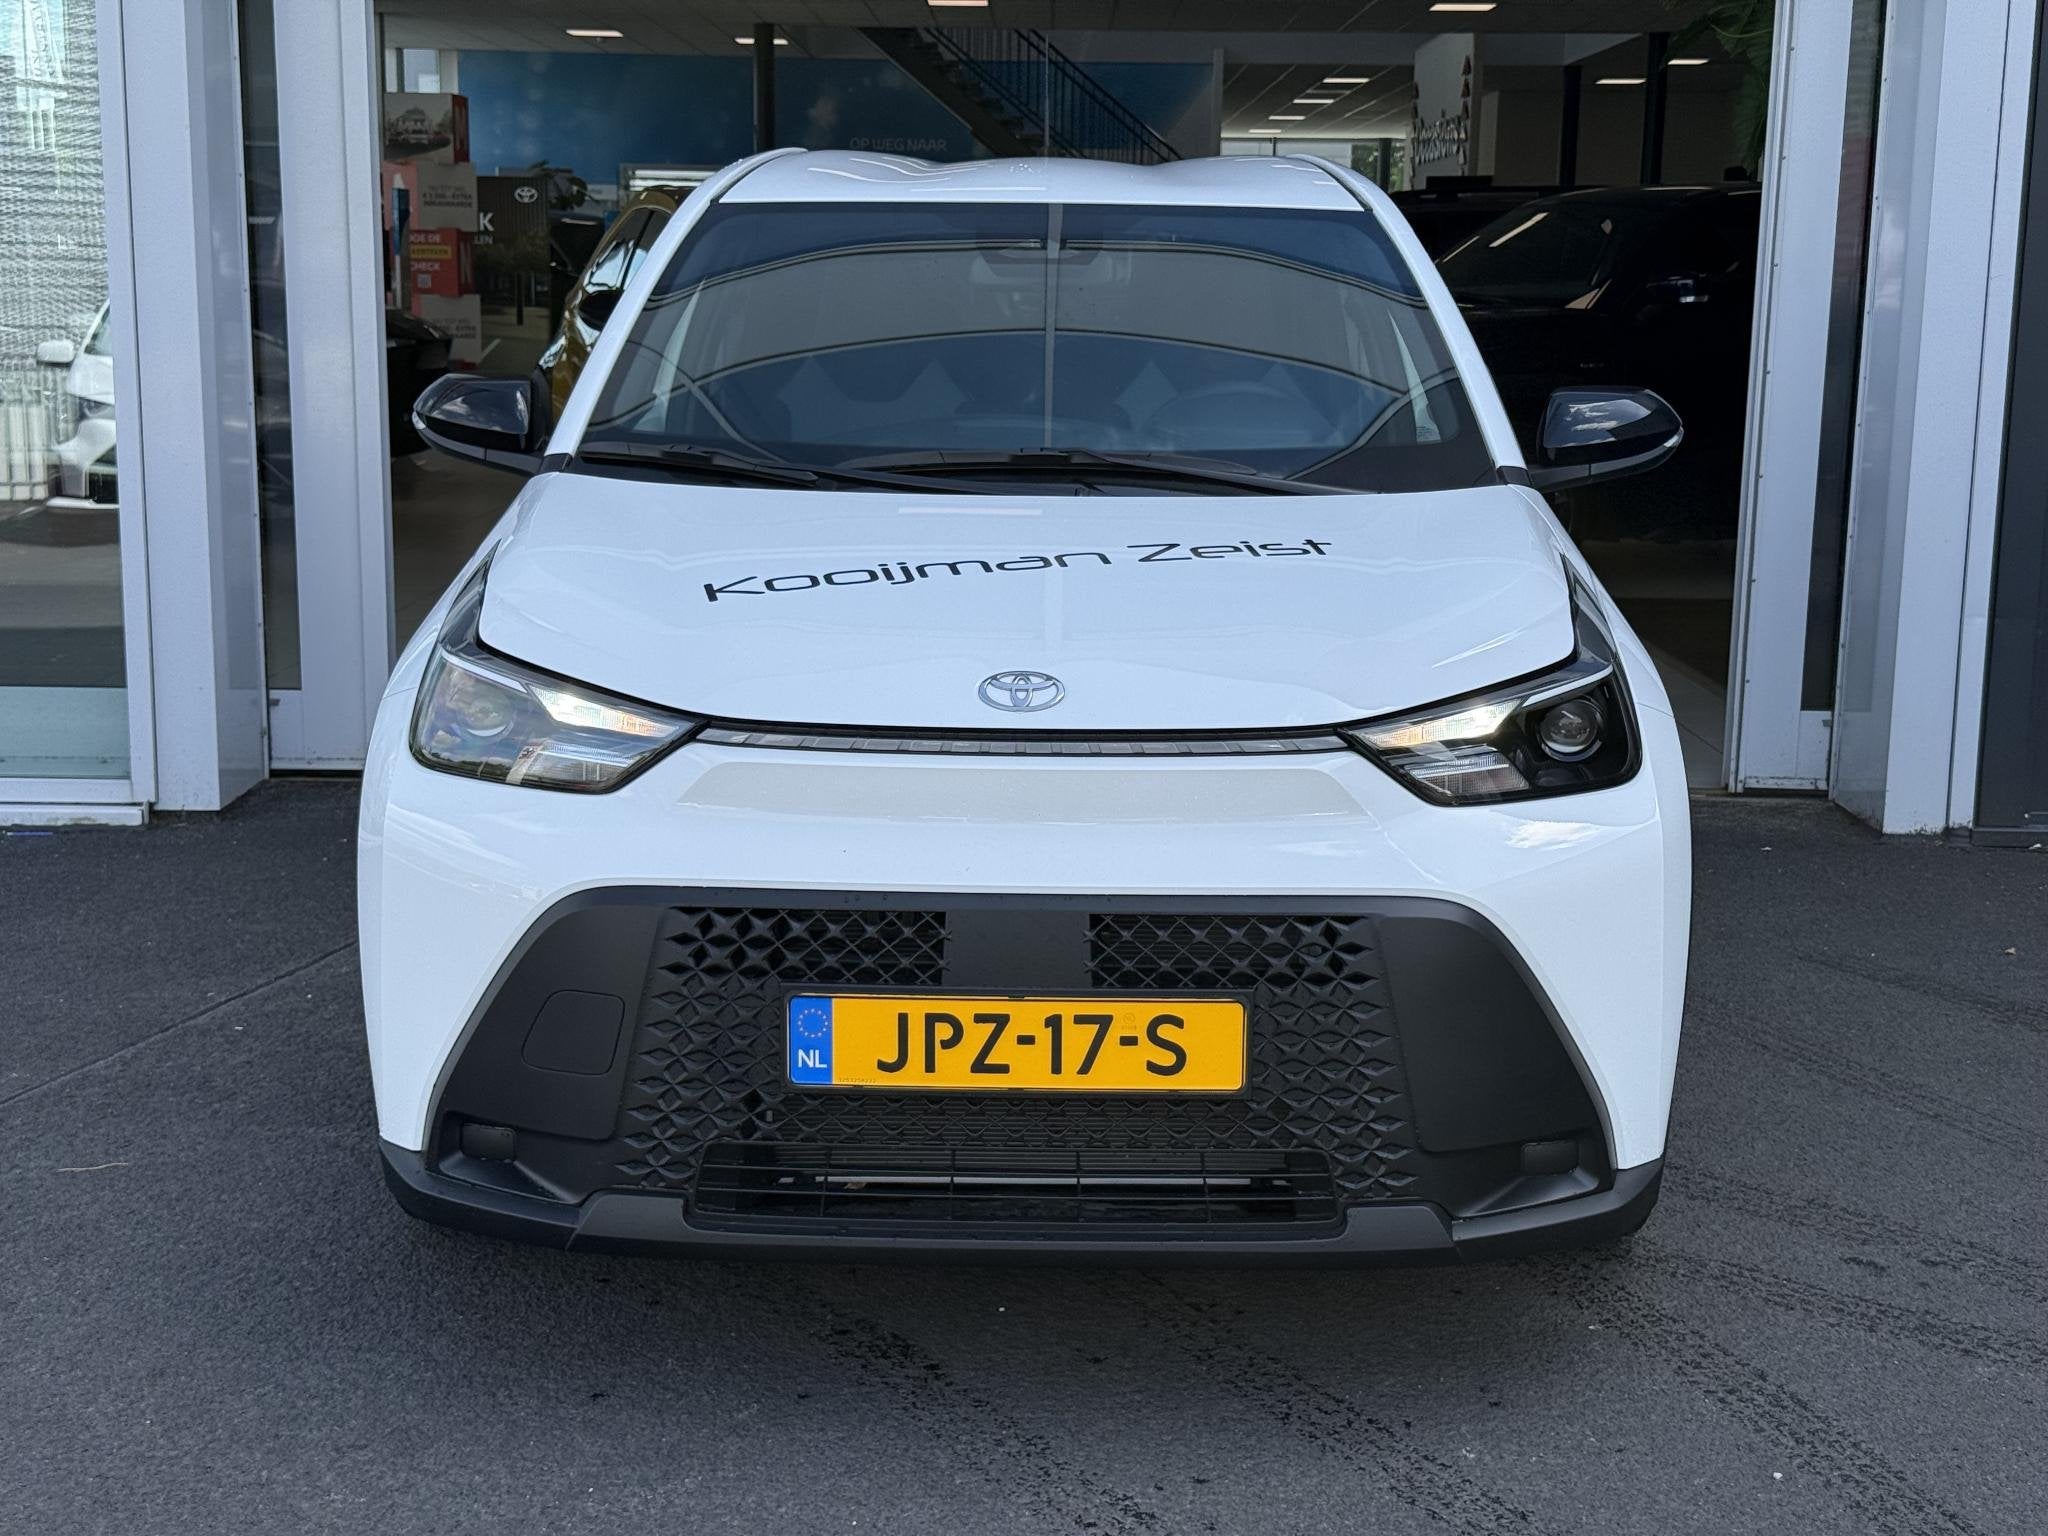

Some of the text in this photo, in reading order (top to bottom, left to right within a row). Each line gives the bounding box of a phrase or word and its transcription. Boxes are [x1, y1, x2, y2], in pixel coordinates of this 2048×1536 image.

[704, 539, 1333, 602] Kooijman Zeist
[798, 1049, 828, 1068] NL
[876, 1012, 1188, 1076] JPZ-17-S
